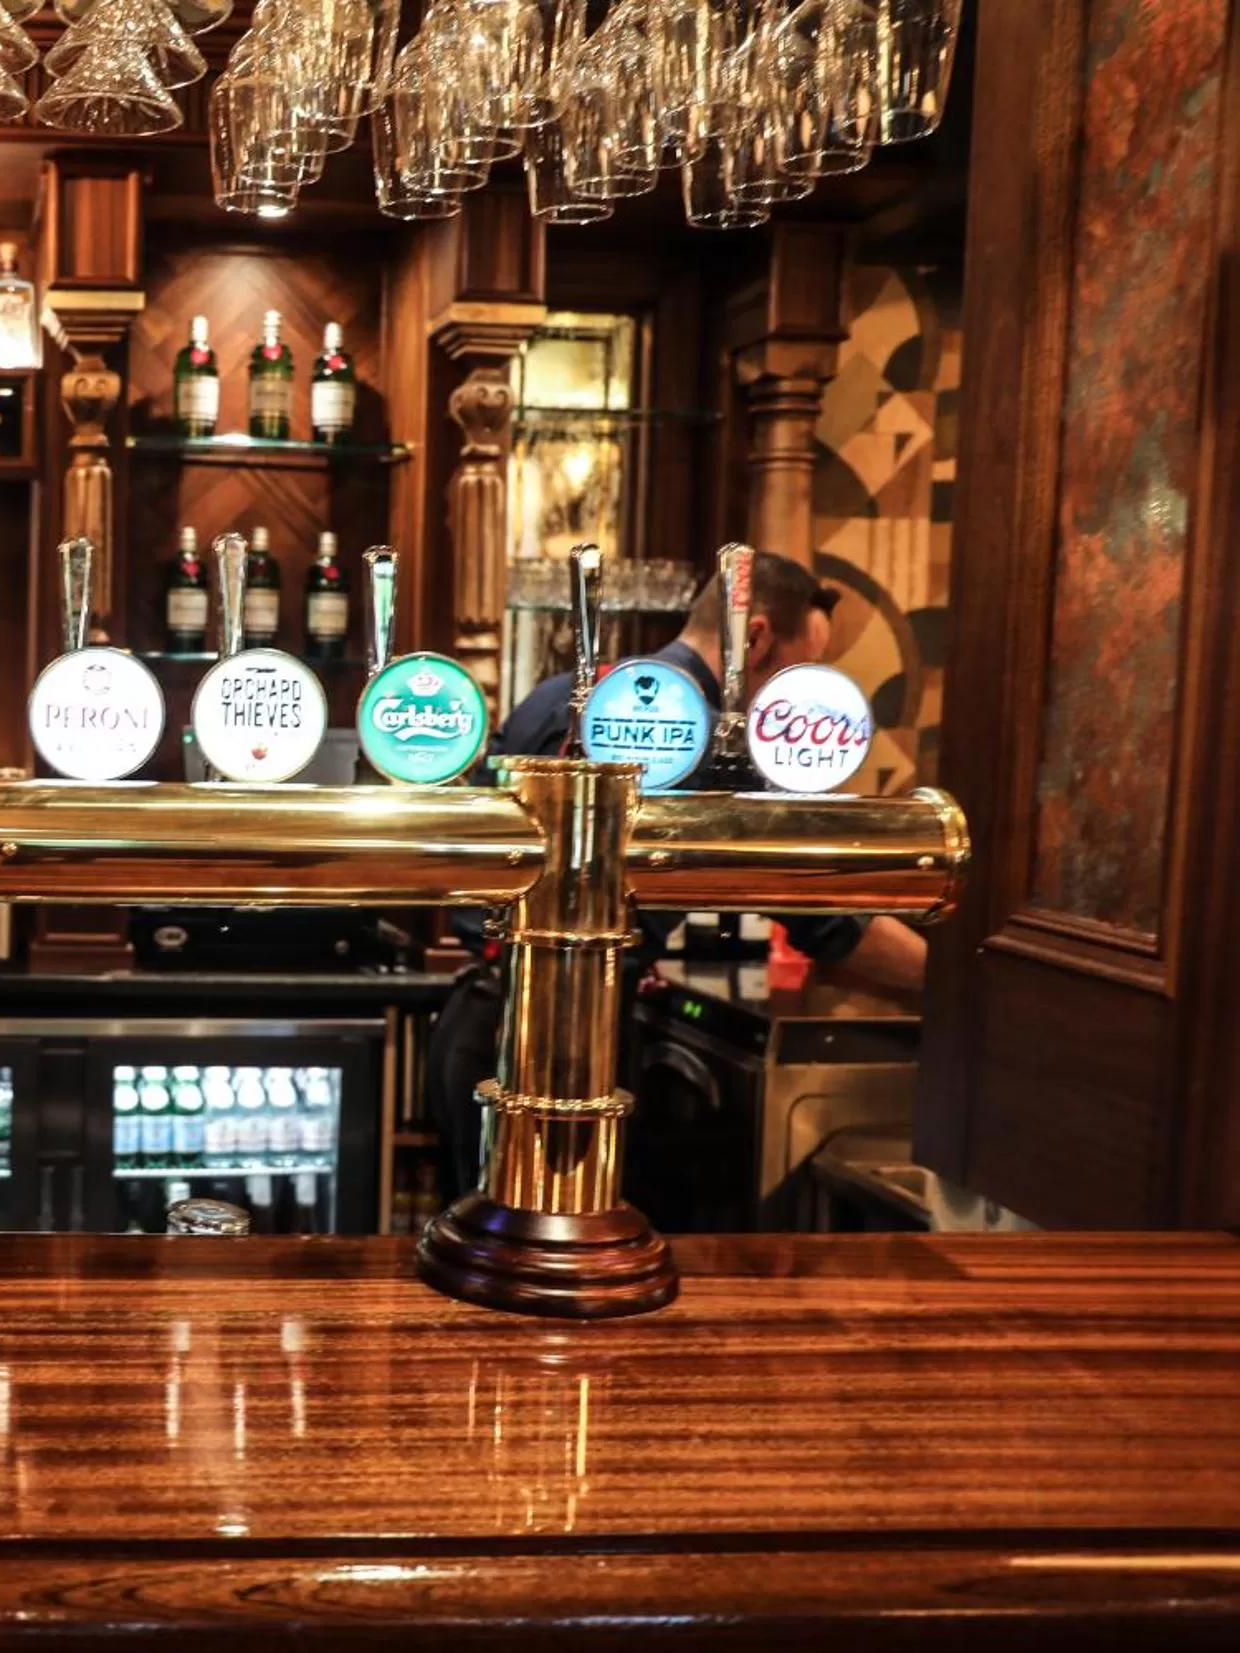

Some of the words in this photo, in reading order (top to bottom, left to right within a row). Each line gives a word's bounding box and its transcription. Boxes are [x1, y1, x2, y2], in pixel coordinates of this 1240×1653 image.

[221, 678, 302, 701] ORCHARD
[45, 703, 149, 730] PERONI
[221, 702, 302, 728] THIEVES
[755, 699, 869, 746] Coors
[591, 724, 656, 744] PUNK
[663, 727, 696, 745] IPA
[774, 746, 850, 768] LIGHT
